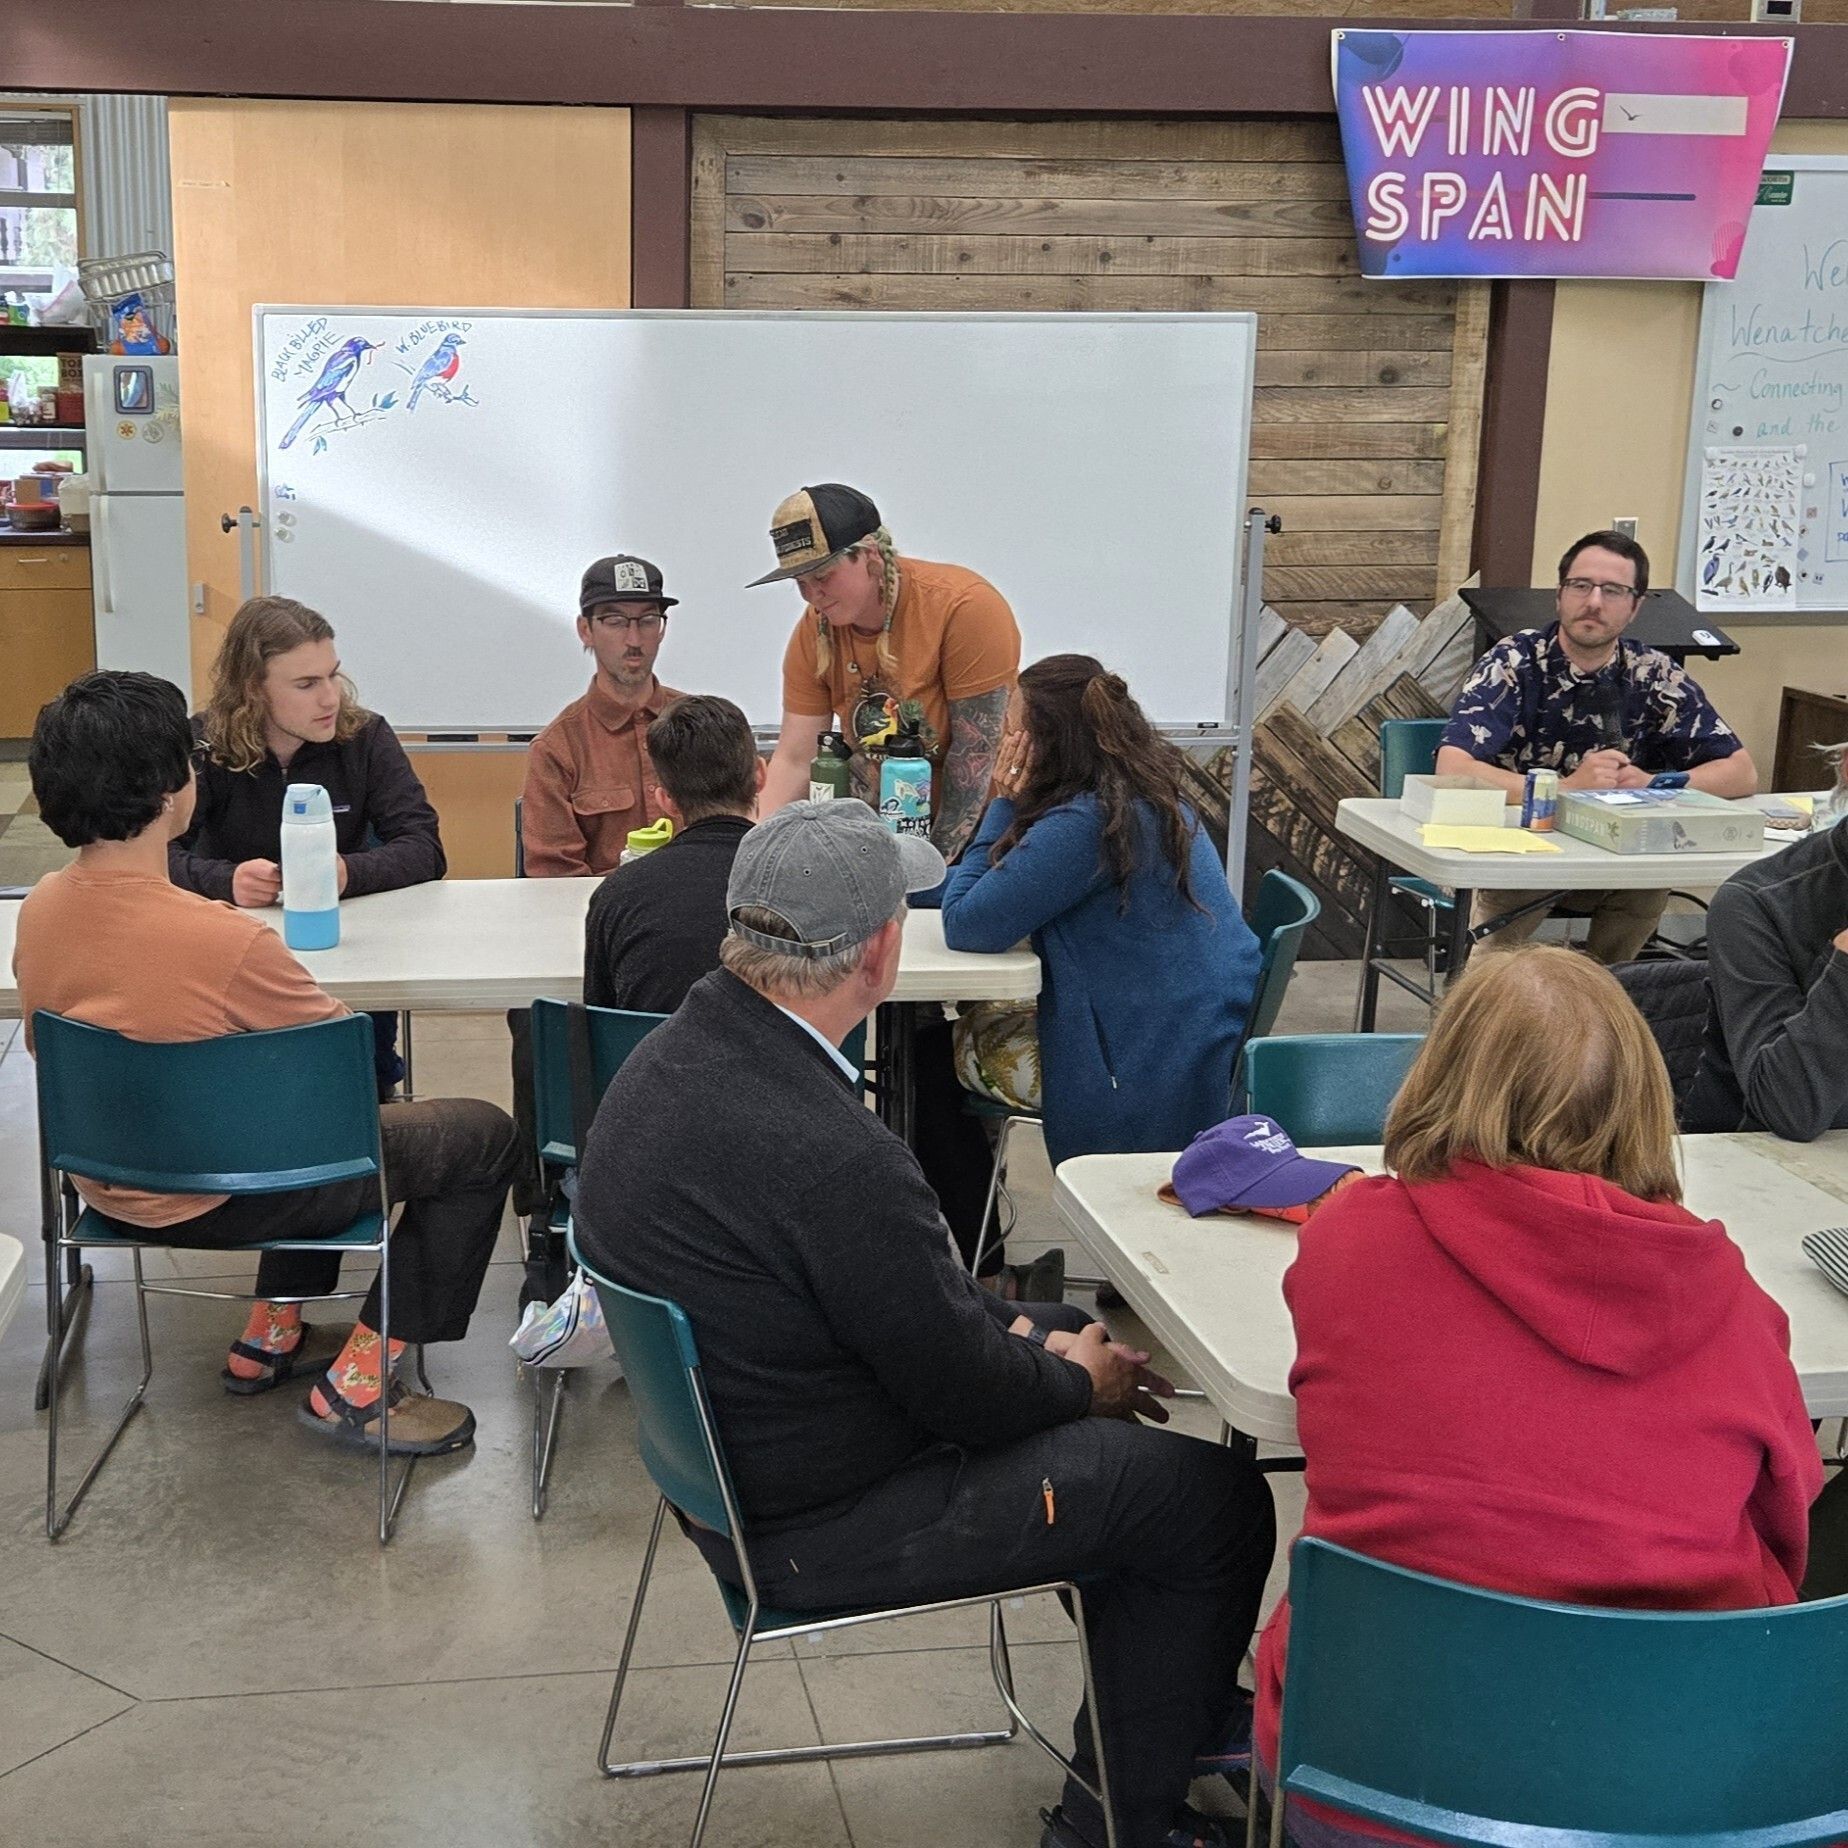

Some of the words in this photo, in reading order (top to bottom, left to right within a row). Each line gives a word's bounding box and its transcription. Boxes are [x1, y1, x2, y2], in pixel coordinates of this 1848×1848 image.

[1361, 86, 1600, 158] WING
[1364, 170, 1588, 242] SPAN
[407, 320, 473, 347] BLUEBIRD
[1750, 367, 1844, 414] Connecting
[1756, 416, 1792, 439] and
[1807, 412, 1841, 434] the
